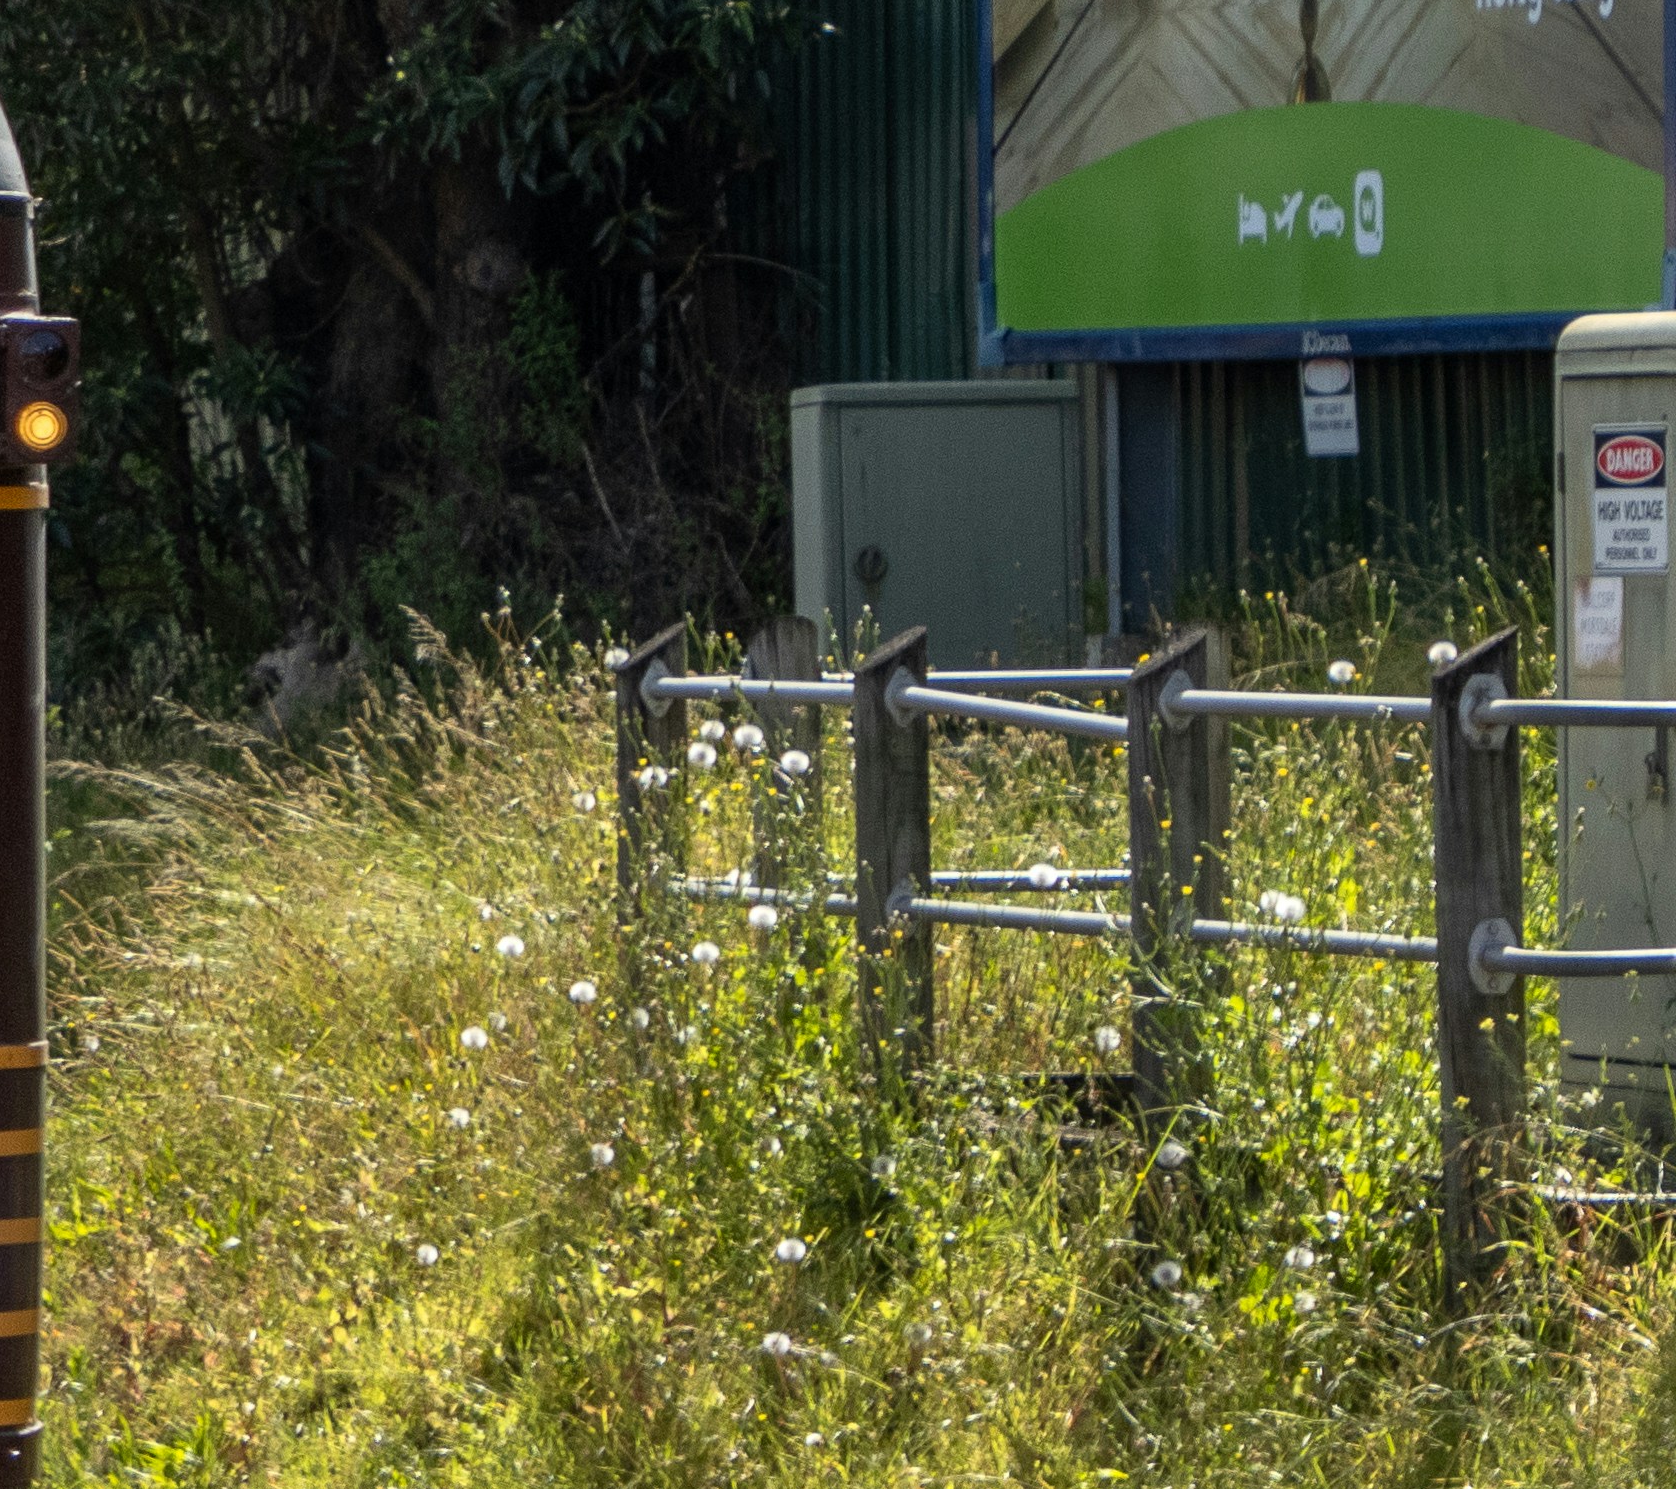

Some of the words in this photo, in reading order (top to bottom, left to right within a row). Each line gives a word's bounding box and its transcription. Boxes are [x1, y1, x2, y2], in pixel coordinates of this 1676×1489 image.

[1605, 446, 1655, 473] DANGER
[1597, 499, 1621, 521] HIGH
[1623, 499, 1665, 522] VOLTAGE
